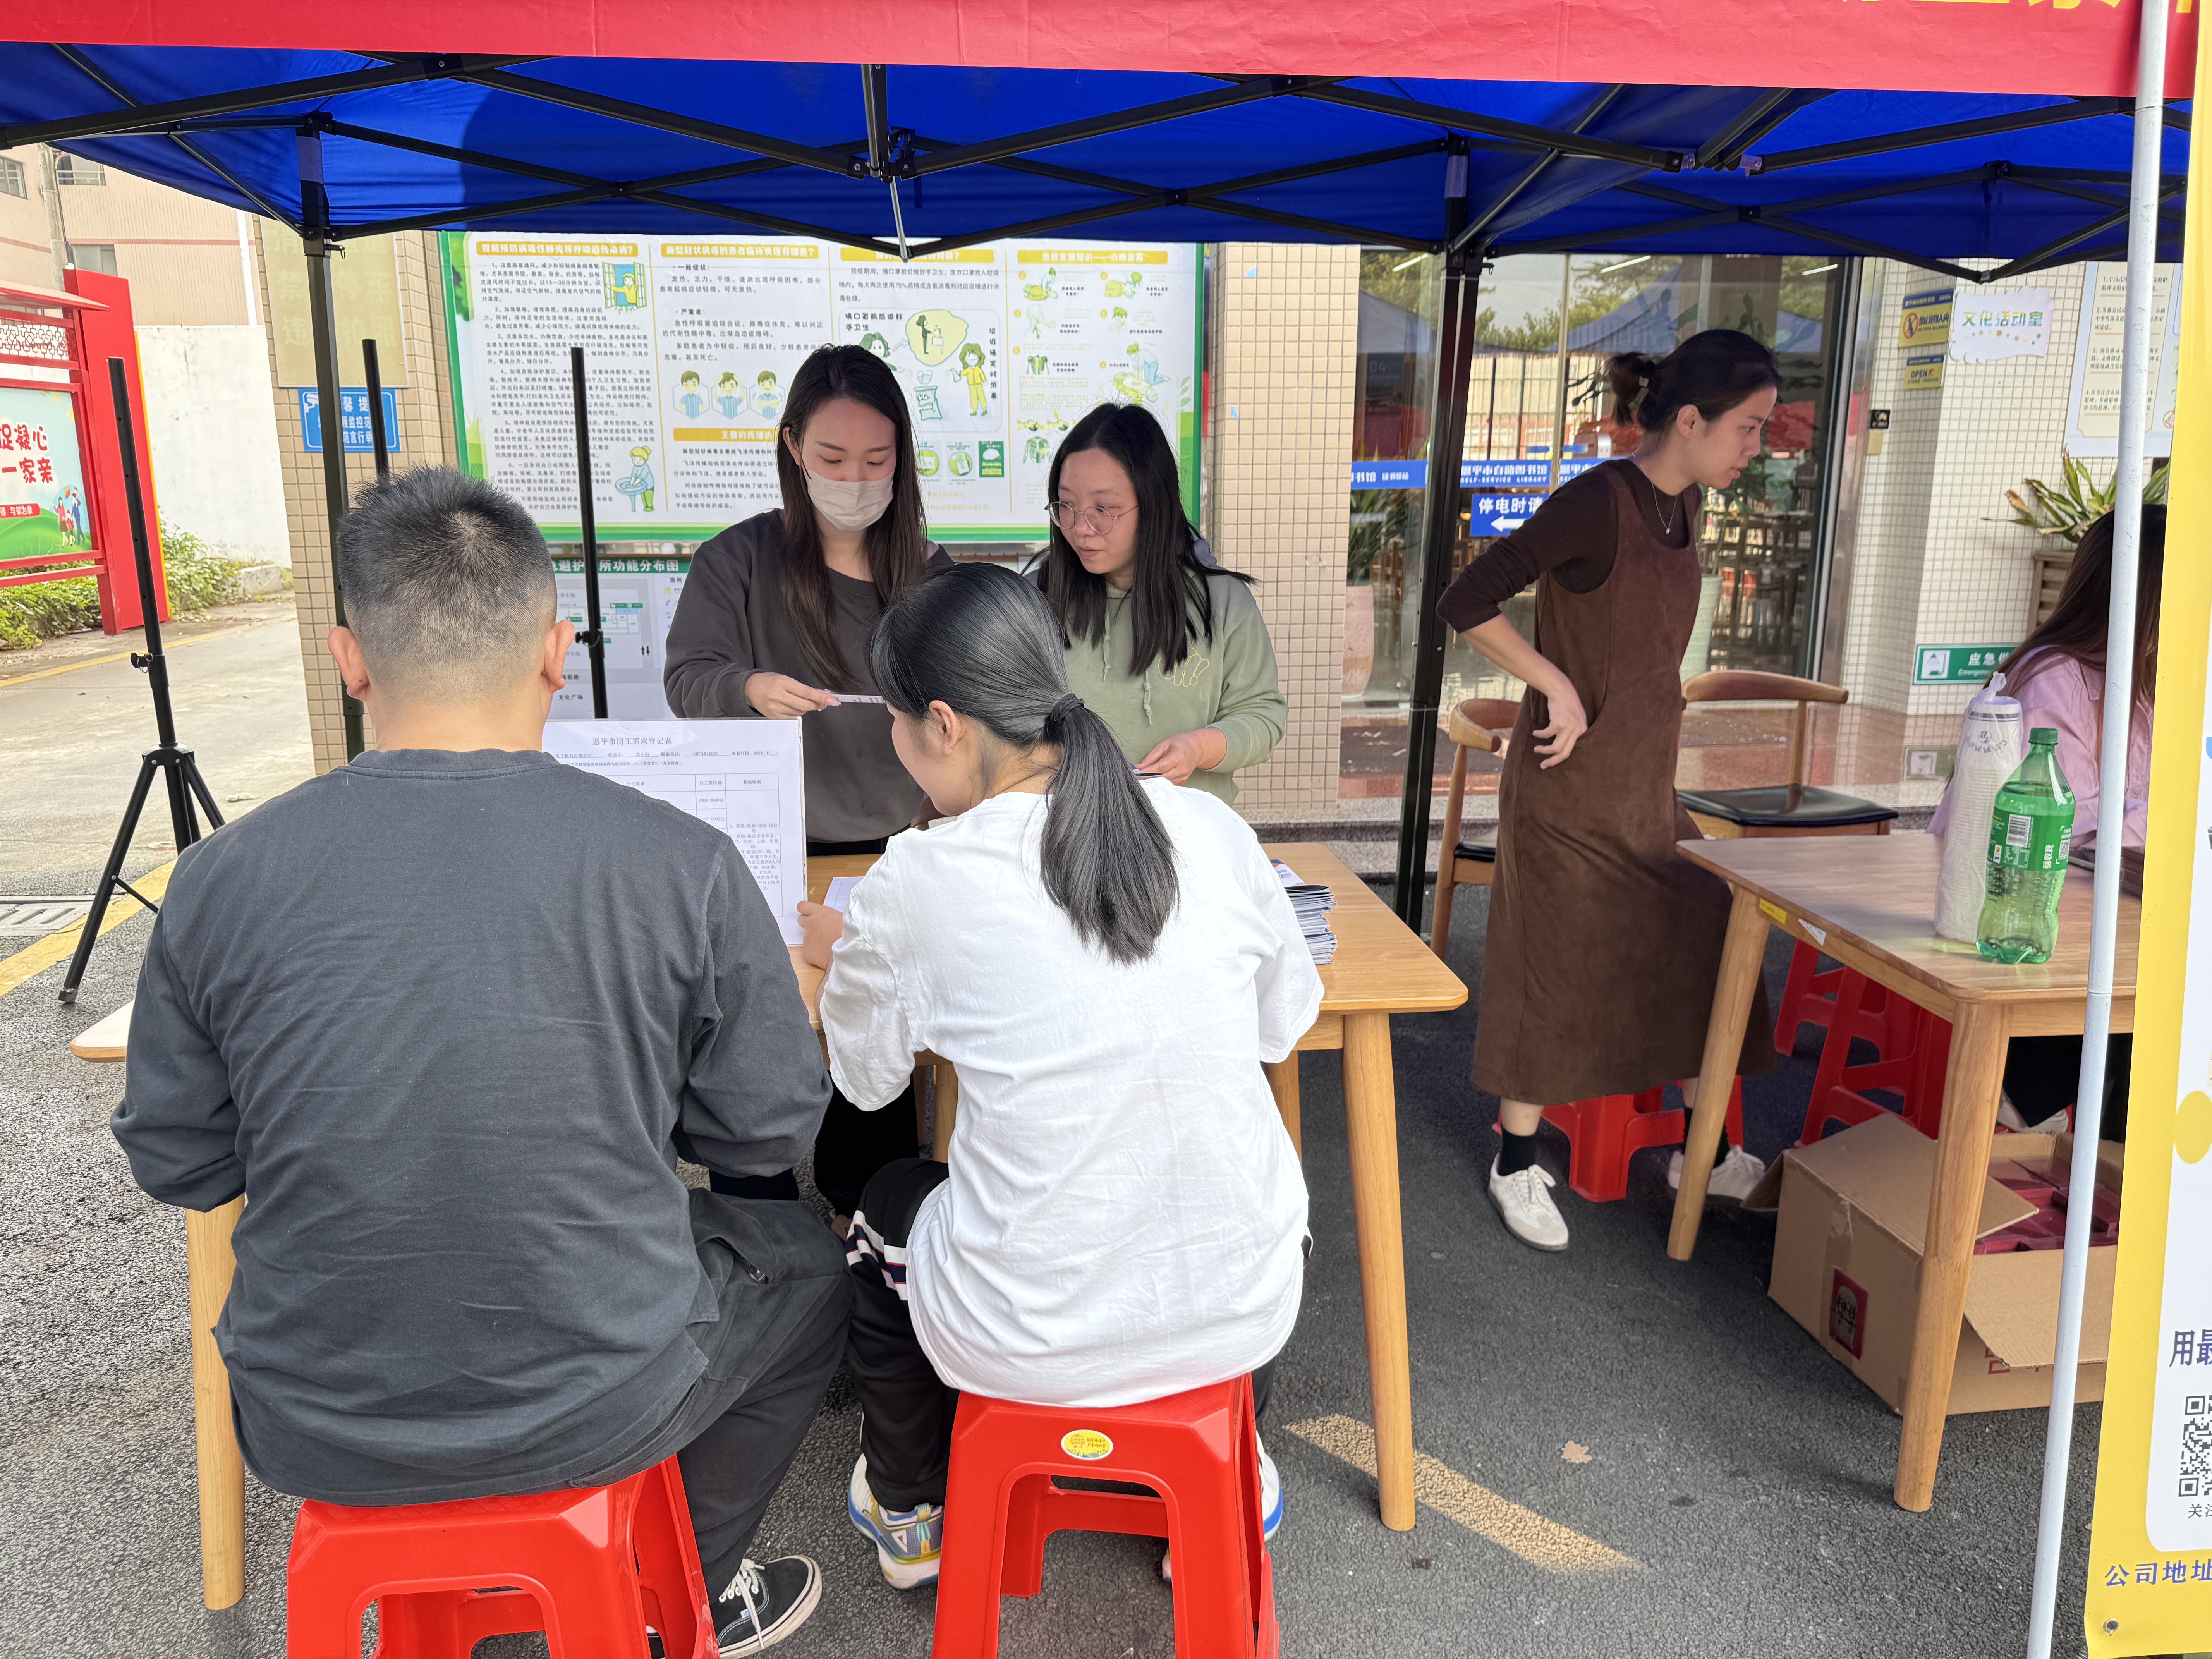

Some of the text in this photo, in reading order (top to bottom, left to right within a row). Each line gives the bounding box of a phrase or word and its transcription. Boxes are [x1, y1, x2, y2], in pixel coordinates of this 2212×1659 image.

[1961, 310, 2044, 327] 文化活动室
[592, 737, 672, 745] 恩平市用工需求登记表
[2104, 1558, 2212, 1587] 公司地址
